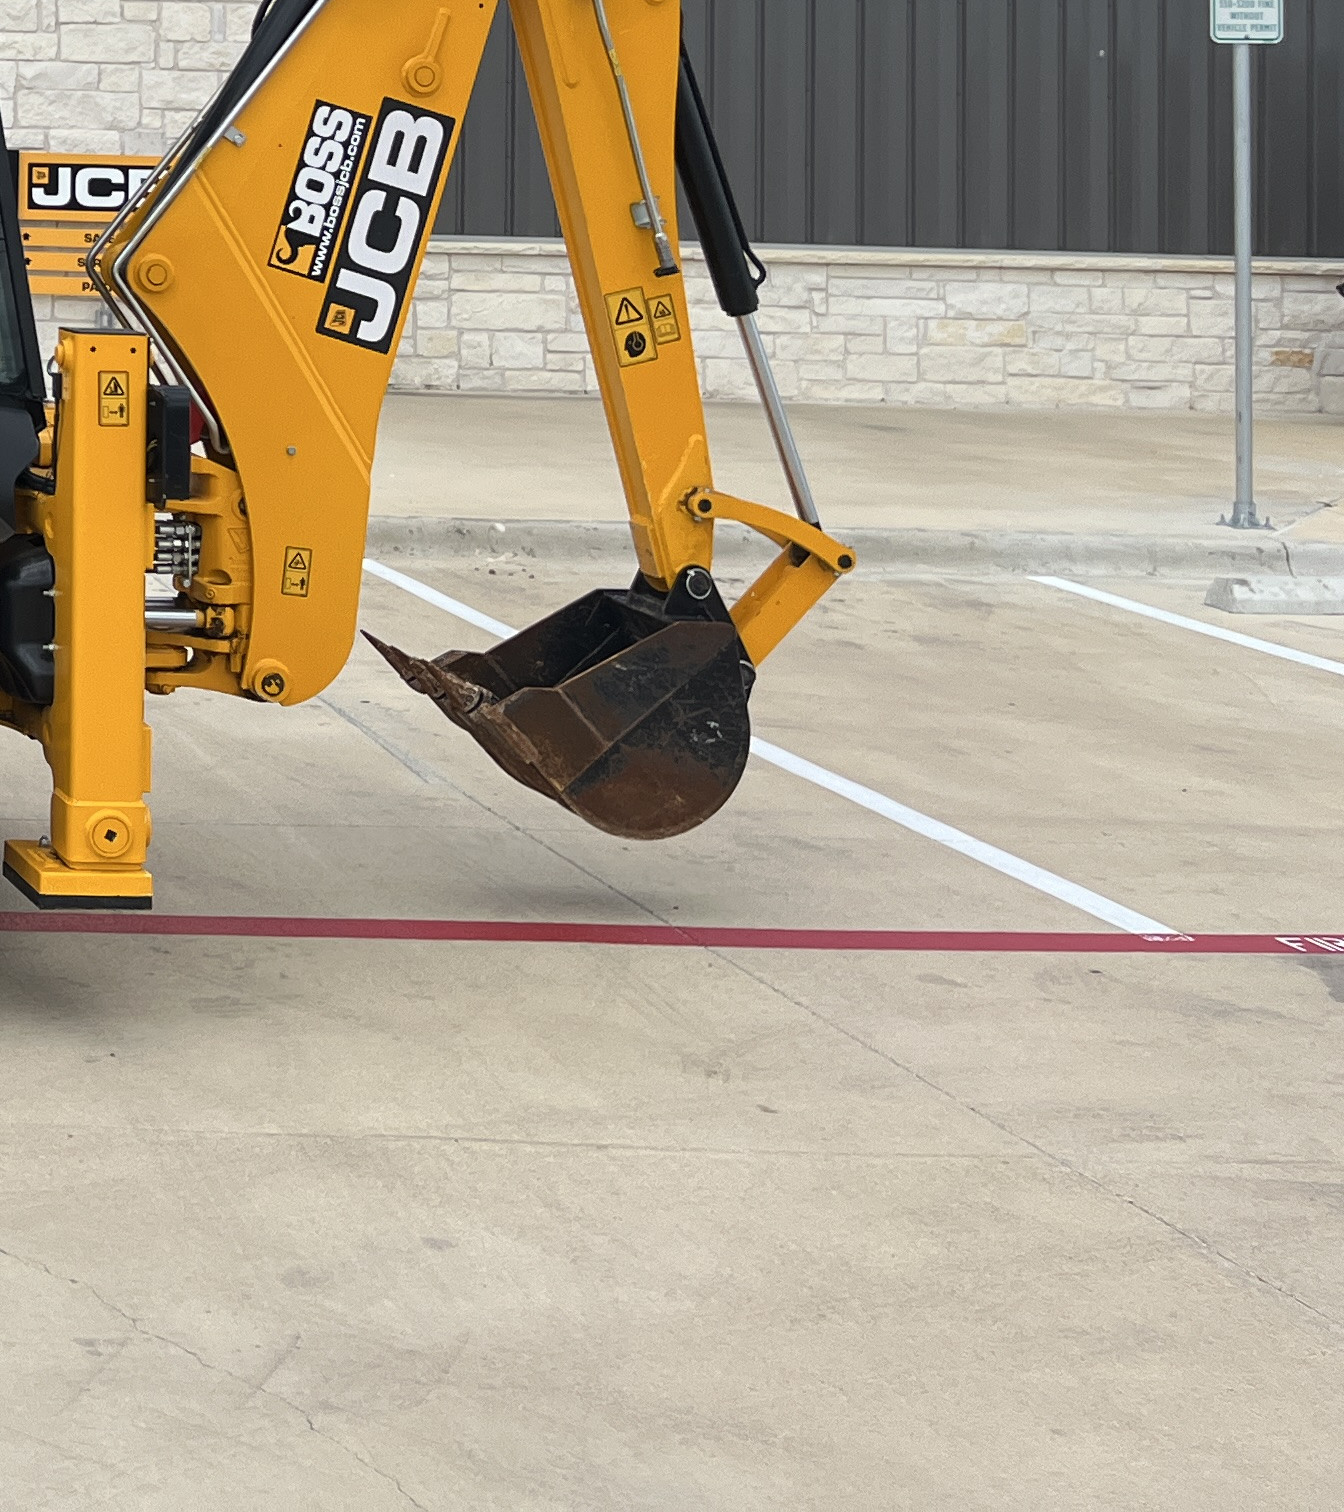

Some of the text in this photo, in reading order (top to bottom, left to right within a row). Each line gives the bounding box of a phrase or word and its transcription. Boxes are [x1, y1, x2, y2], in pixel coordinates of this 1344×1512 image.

[288, 105, 353, 238] BOSS
[311, 117, 366, 277] www.bossjcb.com
[336, 109, 445, 343] JCB
